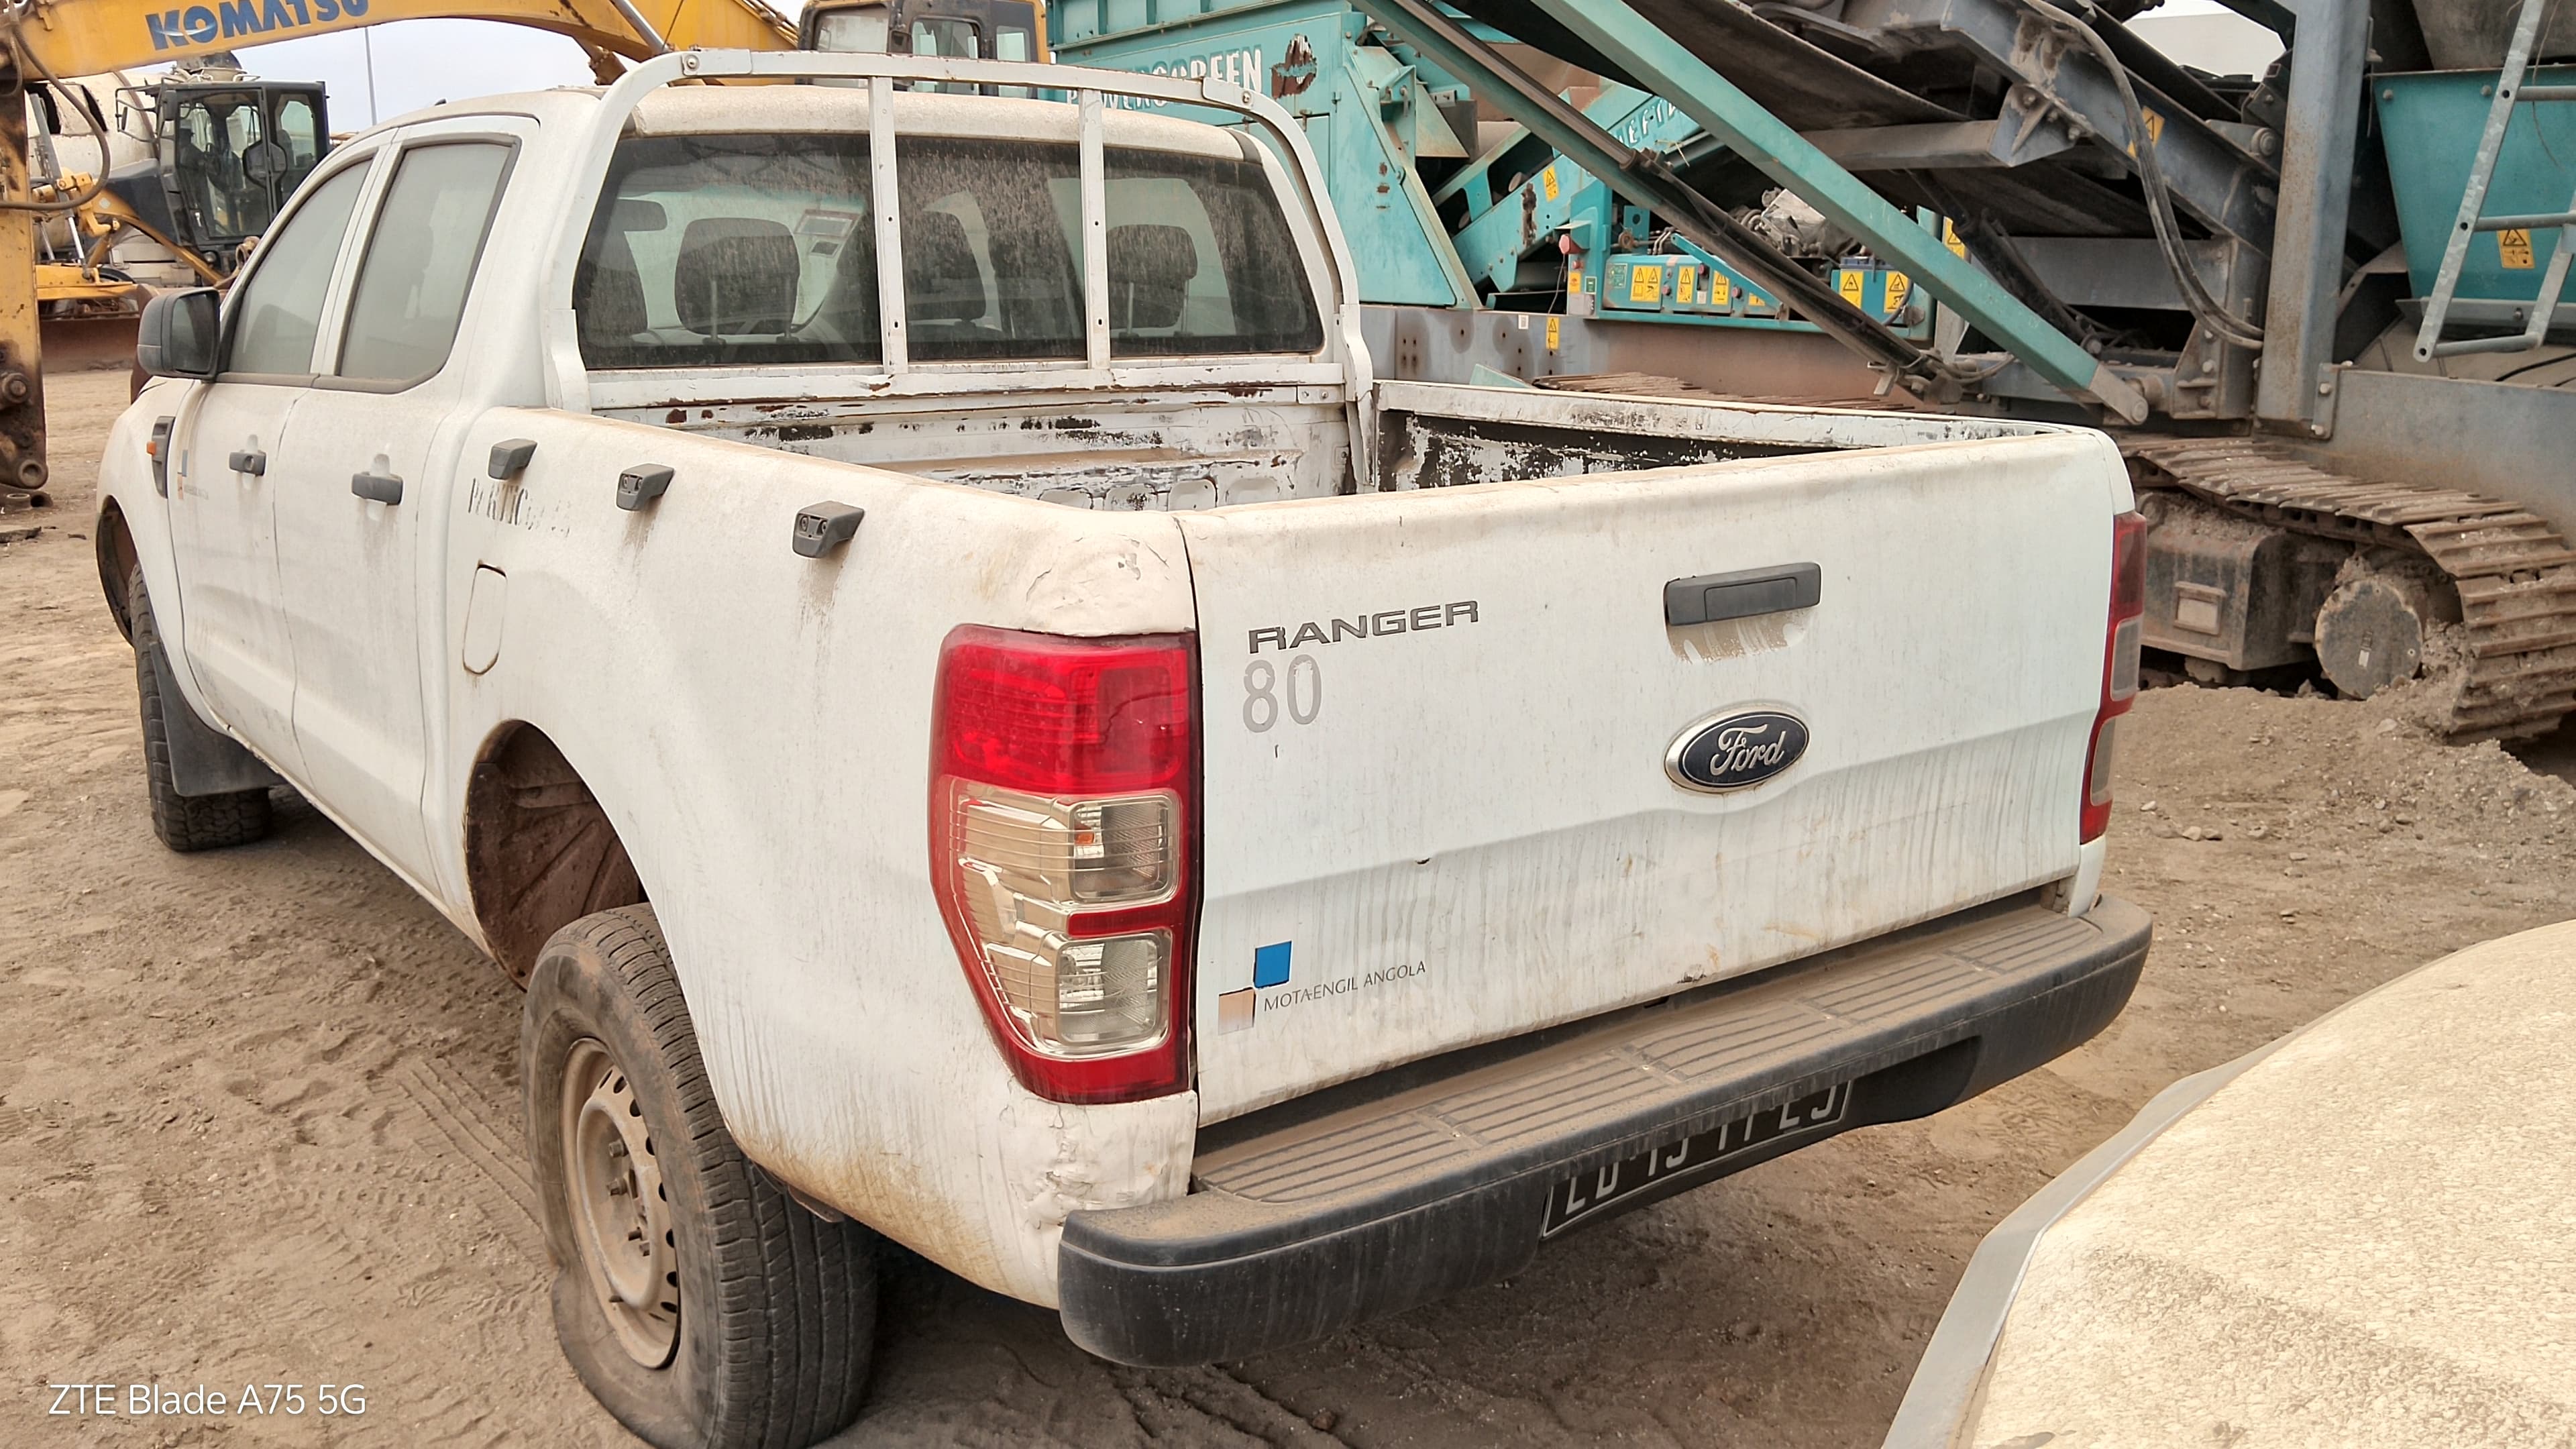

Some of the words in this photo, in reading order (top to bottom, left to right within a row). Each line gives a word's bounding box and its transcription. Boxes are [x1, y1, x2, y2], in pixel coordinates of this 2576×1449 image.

[146, 0, 369, 50] KOMATSU
[1248, 600, 1479, 654] RANGER
[1242, 655, 1322, 733] 80
[1710, 723, 1786, 775] Ford
[1363, 961, 1426, 987] ANGOLA
